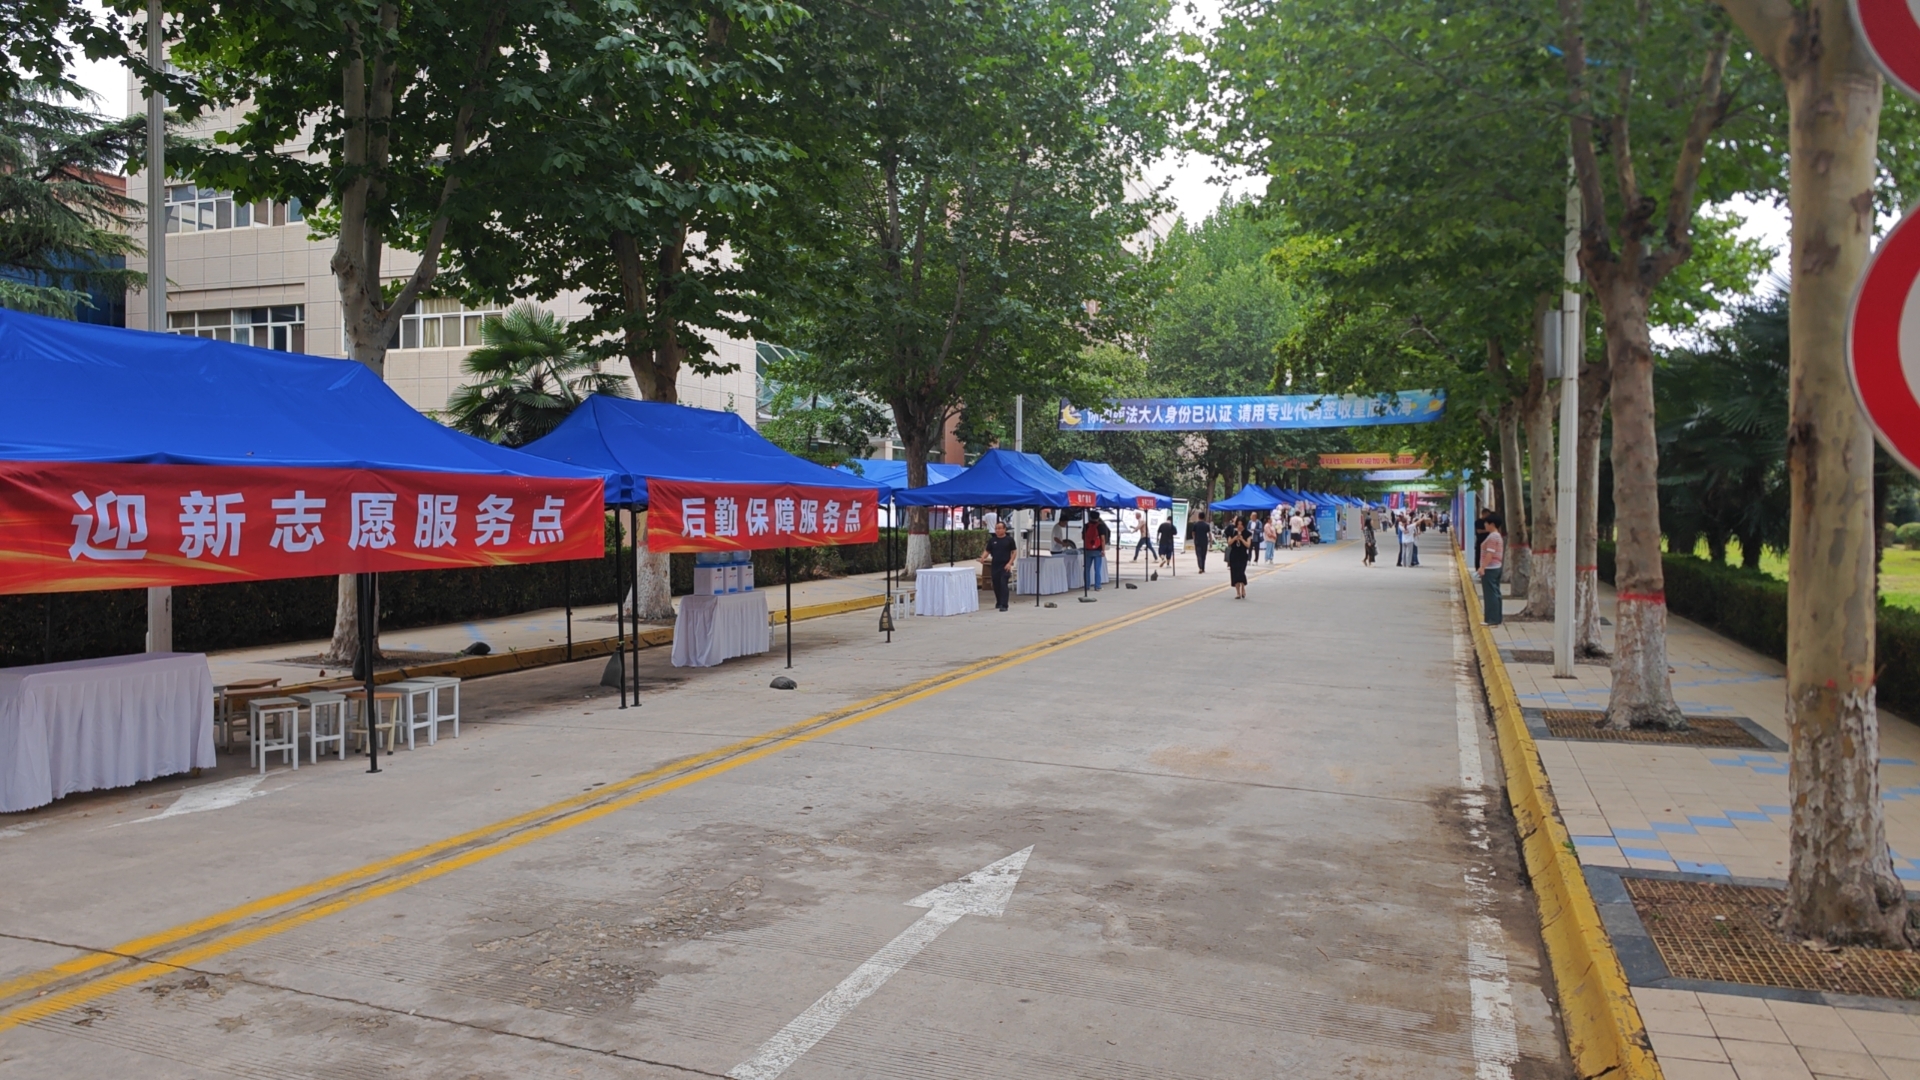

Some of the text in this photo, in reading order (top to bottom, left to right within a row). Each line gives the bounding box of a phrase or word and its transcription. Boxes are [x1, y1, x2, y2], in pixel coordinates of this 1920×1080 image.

[69, 490, 566, 562] 迎新志愿服务点
[681, 496, 862, 538] 后勤保障服务点
